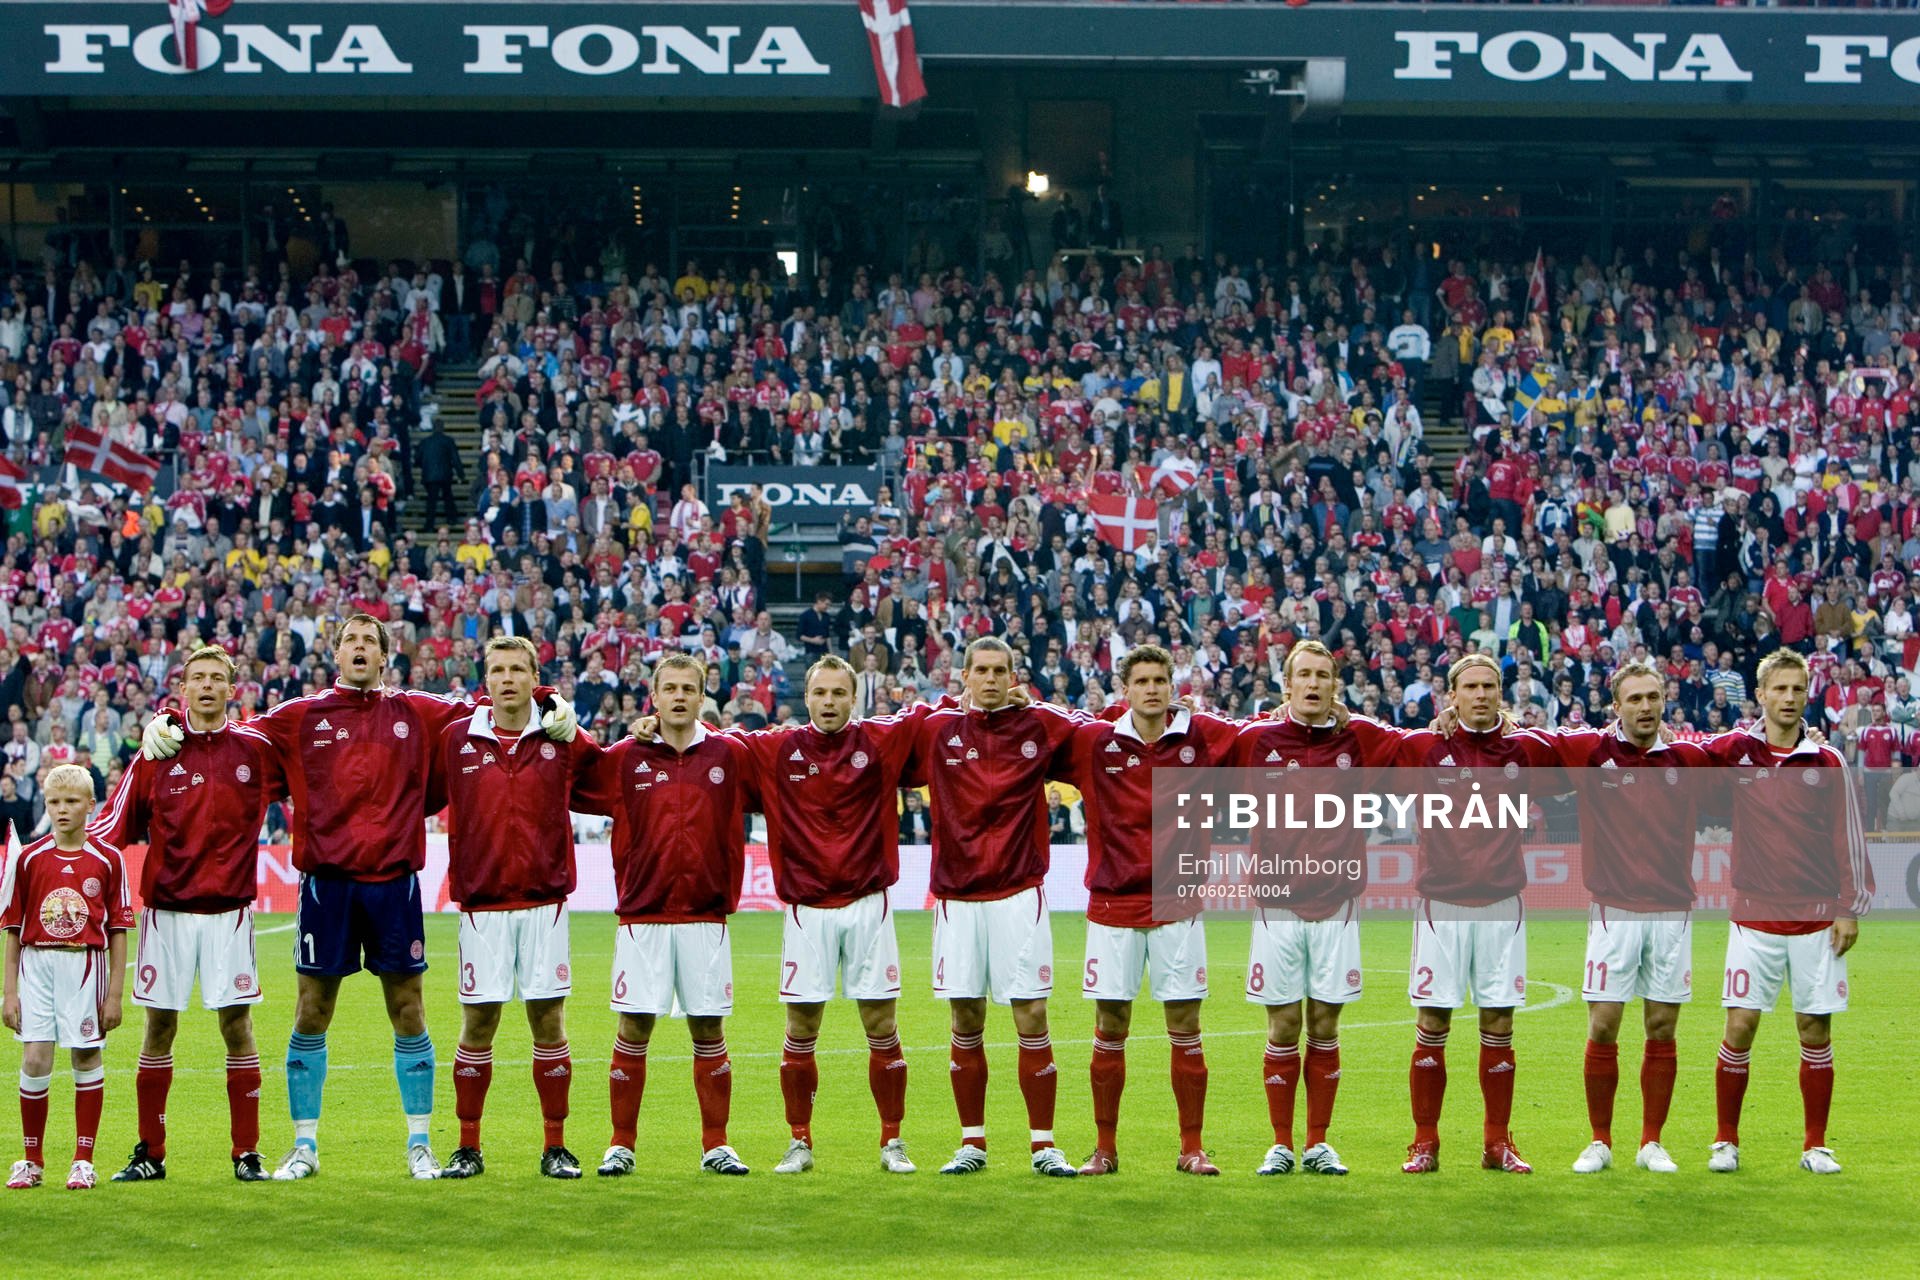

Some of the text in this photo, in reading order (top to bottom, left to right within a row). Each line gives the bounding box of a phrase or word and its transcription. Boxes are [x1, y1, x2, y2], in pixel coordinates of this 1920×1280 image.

[45, 24, 413, 74] FONA
[463, 24, 830, 75] FONA
[1394, 31, 1753, 81] FONA
[304, 933, 315, 963] 1
[140, 965, 157, 994] 9
[464, 962, 476, 992] 3
[614, 970, 627, 999] 6
[785, 961, 798, 989] 7
[936, 956, 945, 986] 4
[1085, 958, 1098, 987] 5
[1250, 963, 1265, 992] 8
[1417, 966, 1433, 996] 2
[1587, 960, 1608, 991] 11
[1726, 967, 1750, 998] 10
